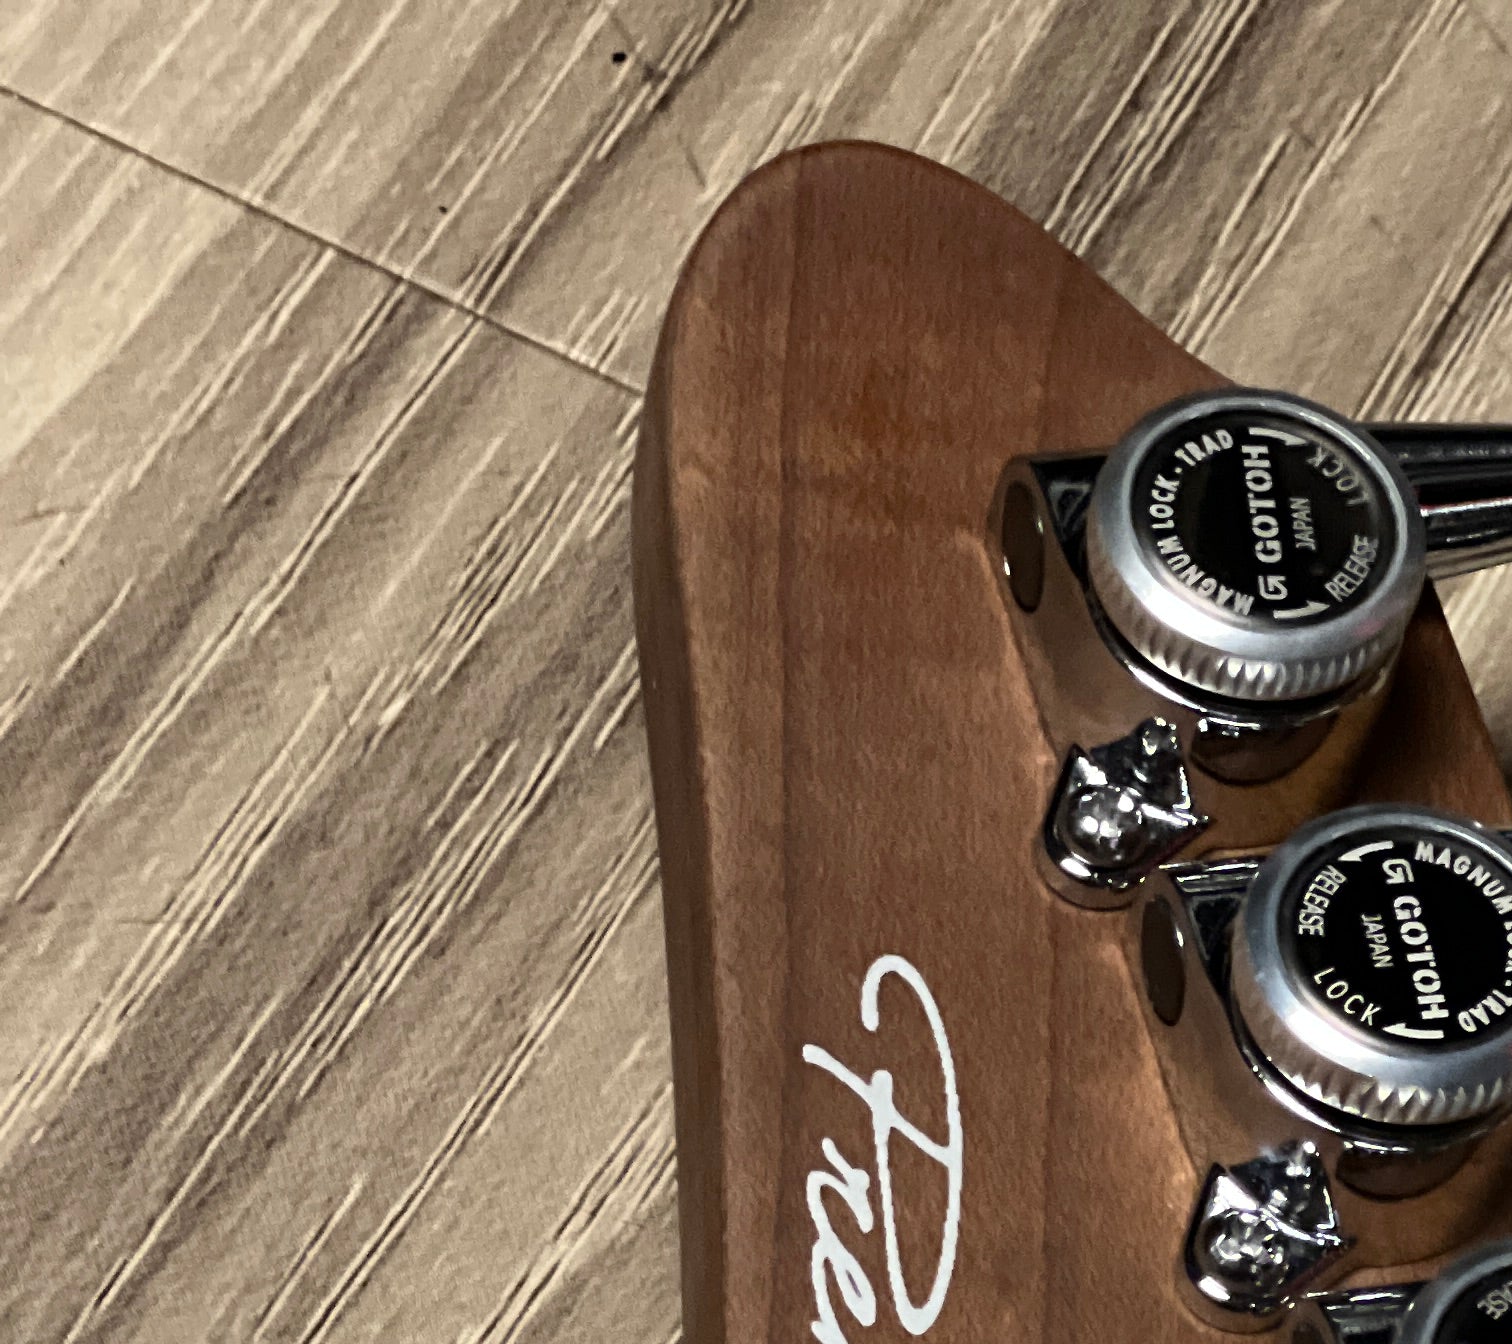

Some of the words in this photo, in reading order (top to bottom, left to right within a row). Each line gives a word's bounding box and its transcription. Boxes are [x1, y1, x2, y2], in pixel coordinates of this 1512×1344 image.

[1174, 428, 1234, 467] TRAD
[1306, 446, 1369, 507] LOCK
[1149, 474, 1181, 530] LOCK
[1241, 444, 1283, 564] GOTOH
[1289, 497, 1316, 550] JAPAN
[1156, 535, 1255, 616] MAGNUM
[1324, 534, 1379, 602] RELEASE
[1298, 864, 1348, 937] RELEASE
[1360, 912, 1394, 968] JAPAN
[1393, 895, 1450, 1020] GOTOH
[1313, 966, 1382, 1027] LOCK
